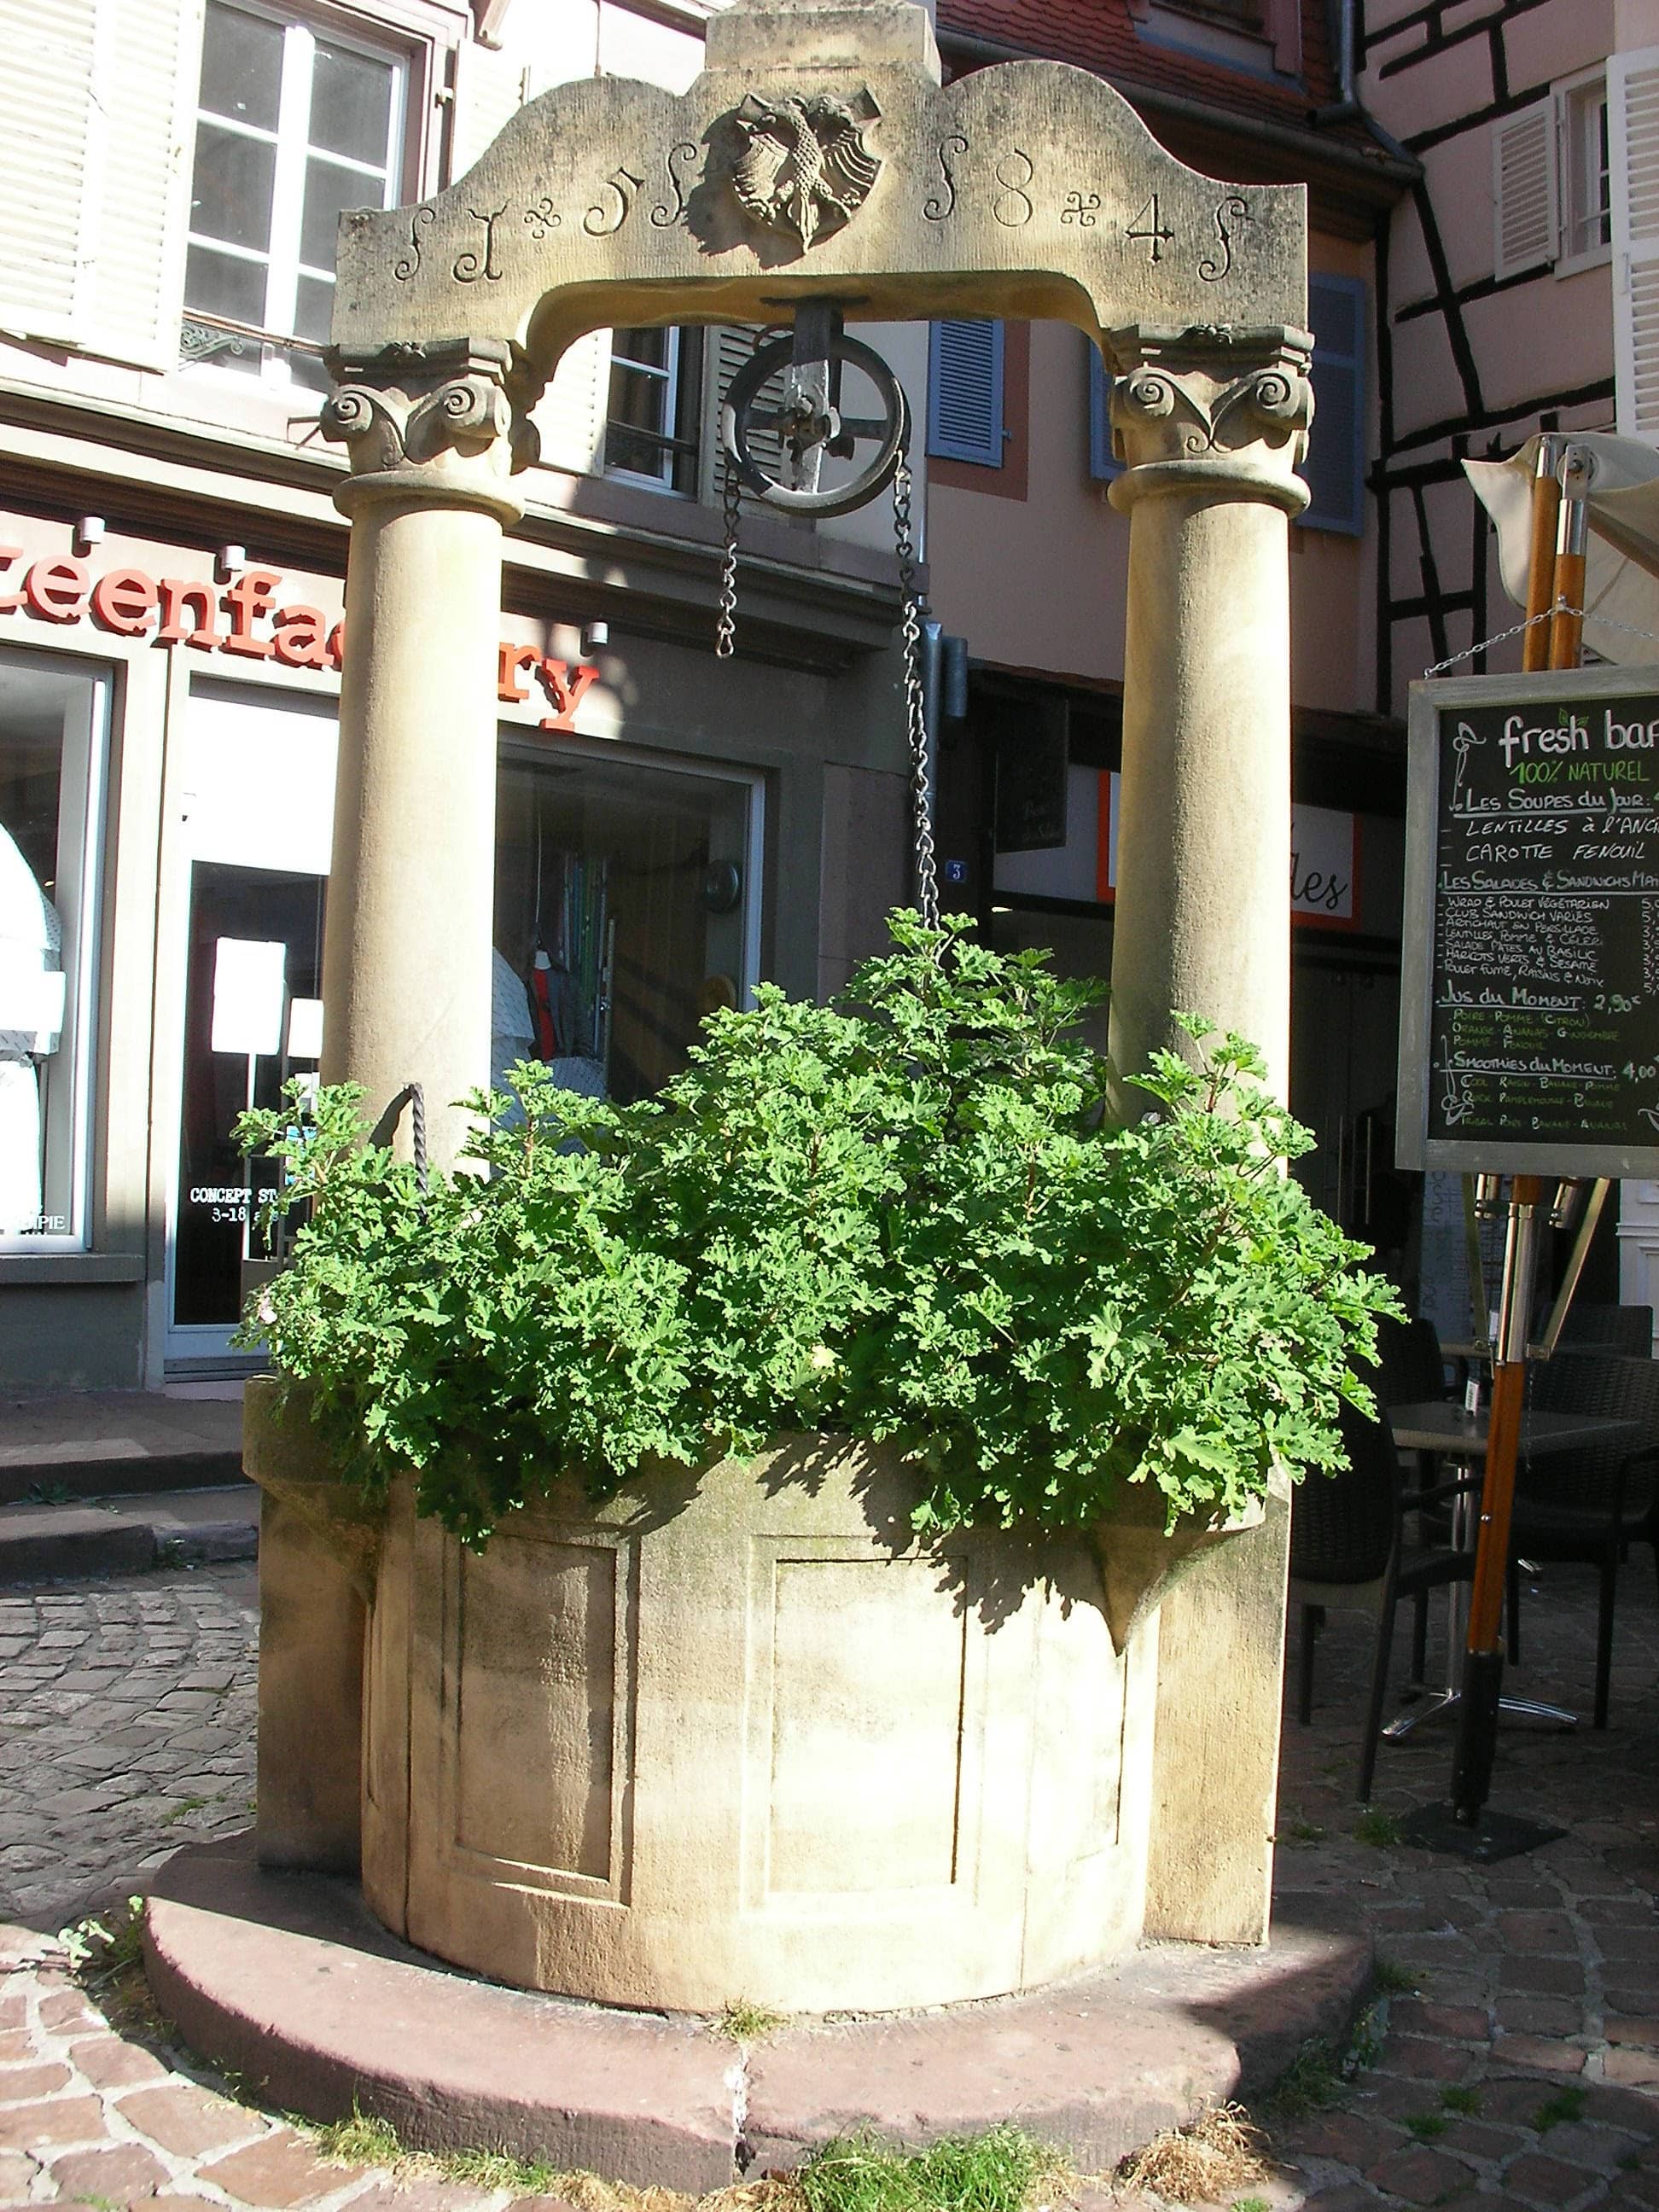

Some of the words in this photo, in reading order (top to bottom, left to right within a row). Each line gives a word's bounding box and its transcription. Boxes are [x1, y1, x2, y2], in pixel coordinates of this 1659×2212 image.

[992, 148, 1033, 227] 8
[1125, 193, 1175, 265] 4
[1498, 714, 1590, 768] fresh
[1509, 760, 1564, 784] 100%
[1568, 760, 1651, 783] NATUREL
[1465, 843, 1554, 863] CAROTTE
[952, 864, 961, 880] 3
[1444, 907, 1480, 920] CLUB
[1482, 907, 1546, 921] SANDWICH
[189, 1187, 253, 1205] CONCEPT
[212, 1206, 247, 1223] 3-18
